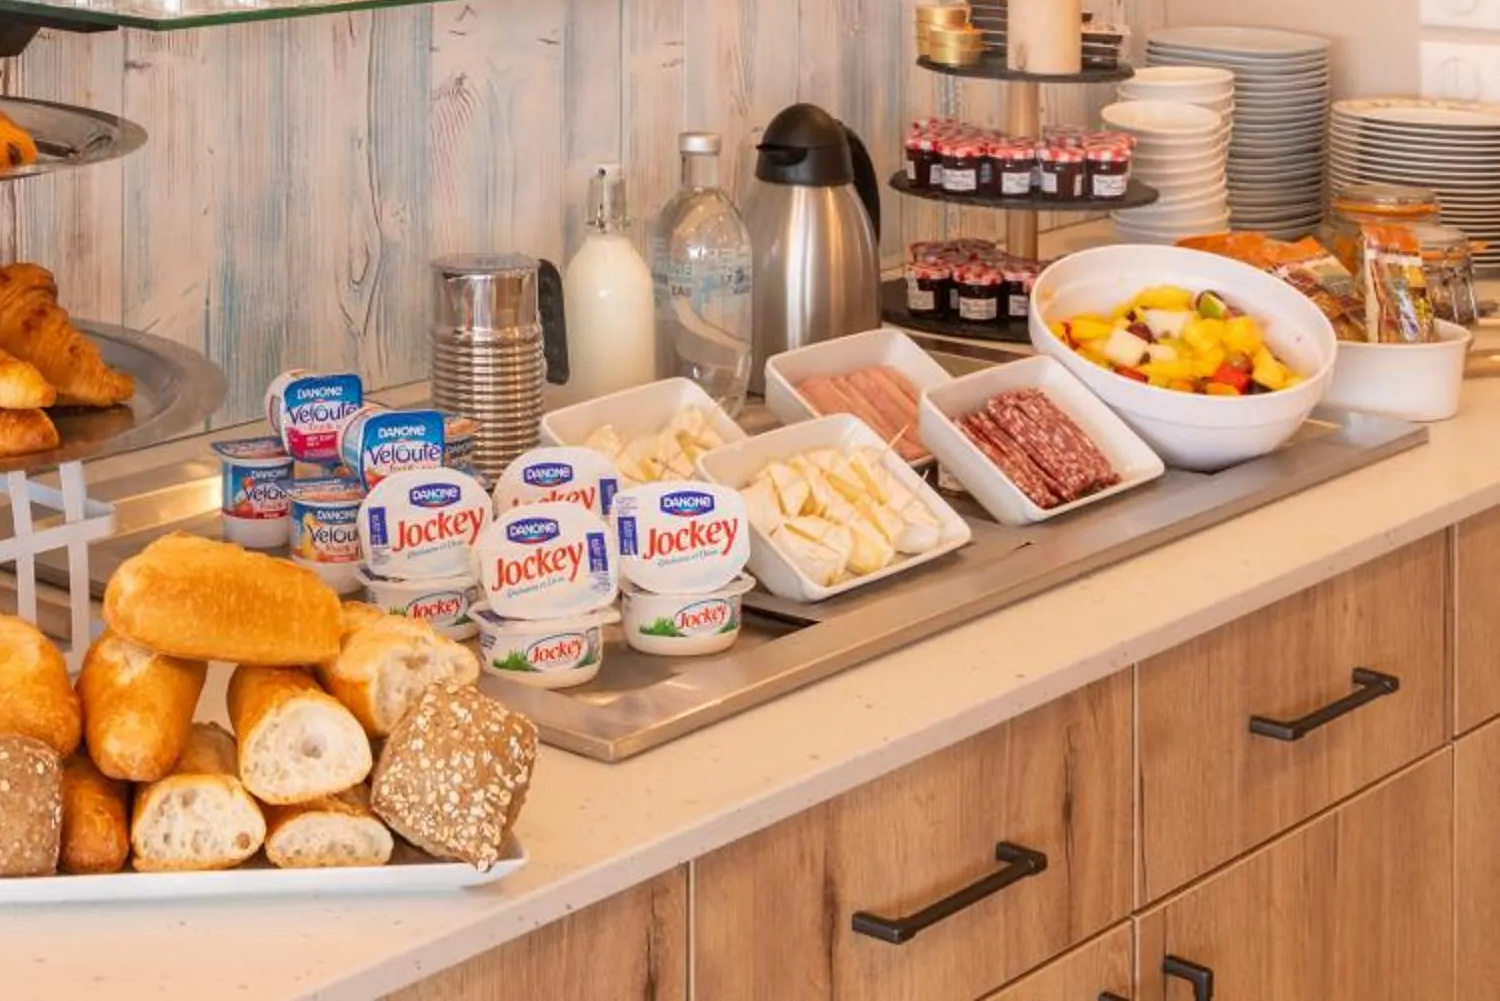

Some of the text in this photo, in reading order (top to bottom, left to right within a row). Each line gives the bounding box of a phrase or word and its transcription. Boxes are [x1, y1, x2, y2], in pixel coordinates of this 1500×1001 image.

[377, 424, 425, 440] DANONE
[411, 487, 459, 502] DANONE
[662, 497, 712, 509] DANONE
[307, 524, 359, 544] Velou
[391, 507, 484, 552] Jockey
[509, 522, 557, 537] DANONE
[643, 518, 739, 560] Jockey
[491, 541, 584, 592] Jockey
[677, 603, 728, 629] Jockey
[530, 637, 582, 664] Jockey
